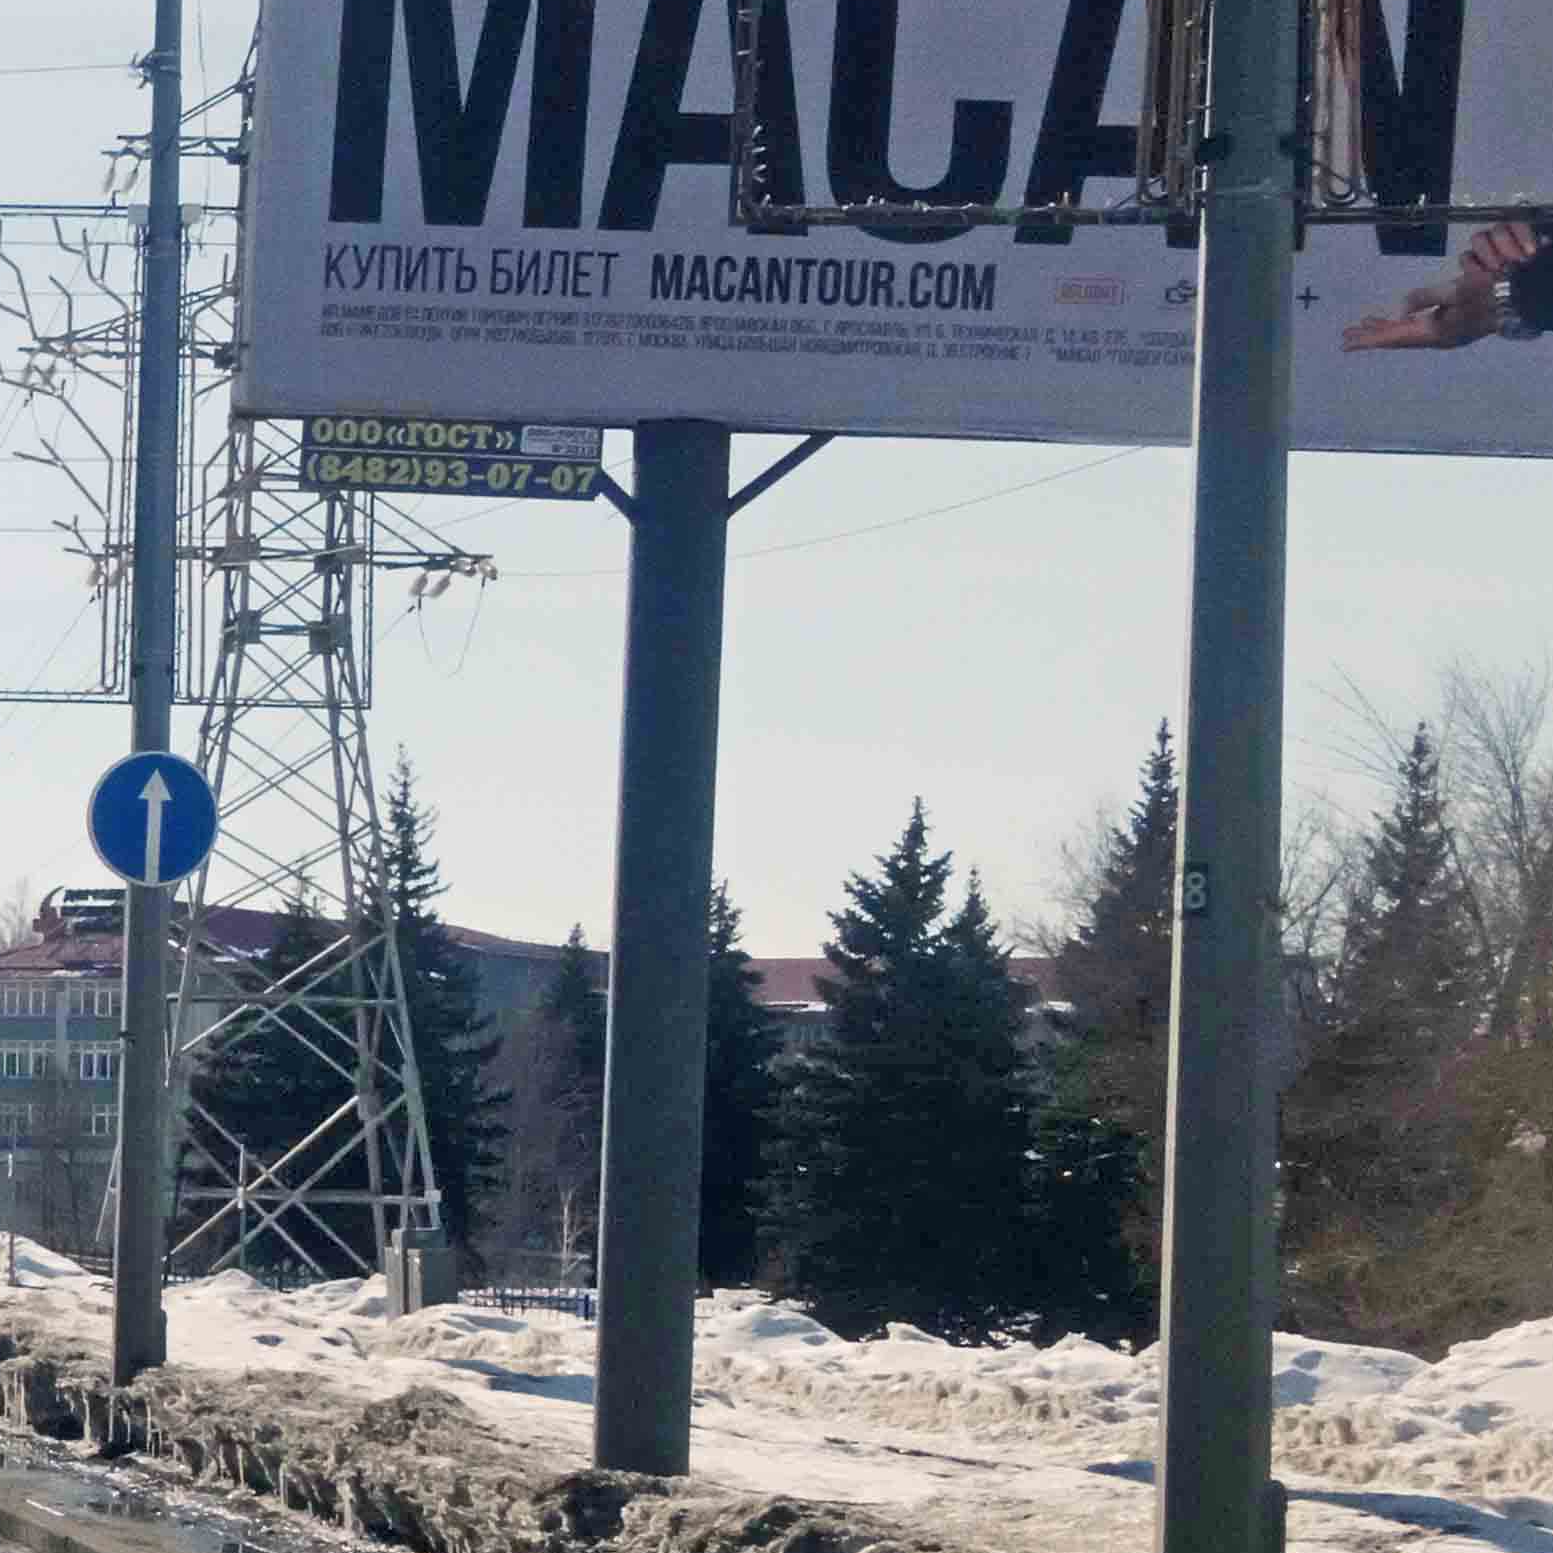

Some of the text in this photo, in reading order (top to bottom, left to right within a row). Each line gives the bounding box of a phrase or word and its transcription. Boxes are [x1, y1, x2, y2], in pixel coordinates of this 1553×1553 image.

[323, 243, 478, 295] КУПИТЬ
[489, 248, 620, 297] БИЛЕТ
[649, 252, 997, 311] MACANTOUR.COM
[1184, 871, 1207, 909] 8
